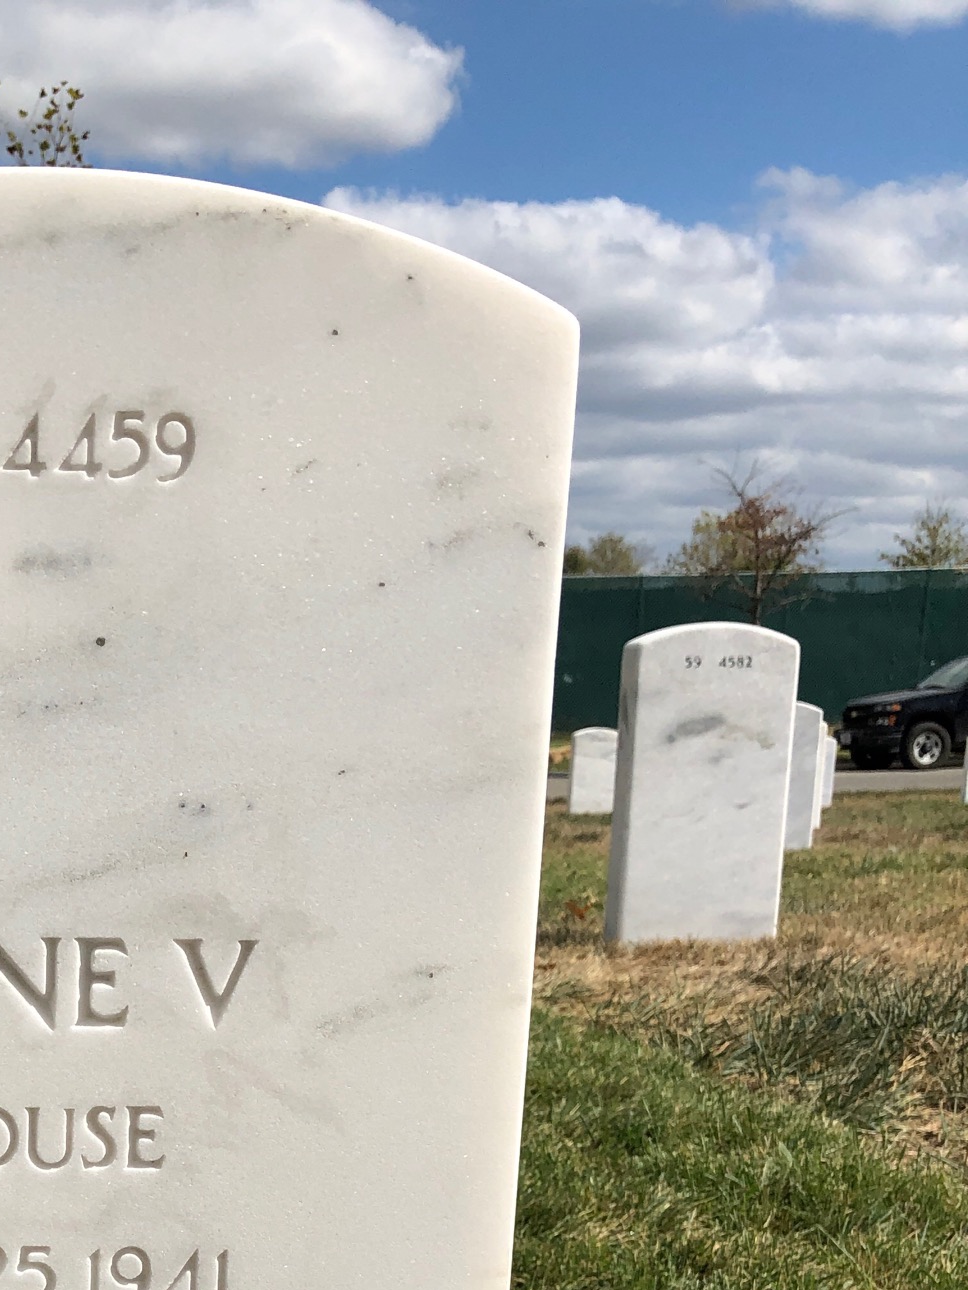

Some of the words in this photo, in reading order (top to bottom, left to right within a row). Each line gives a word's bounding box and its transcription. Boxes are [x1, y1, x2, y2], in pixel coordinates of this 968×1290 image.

[0, 408, 197, 483] 4459
[685, 655, 702, 668] 59
[172, 937, 260, 1030] V
